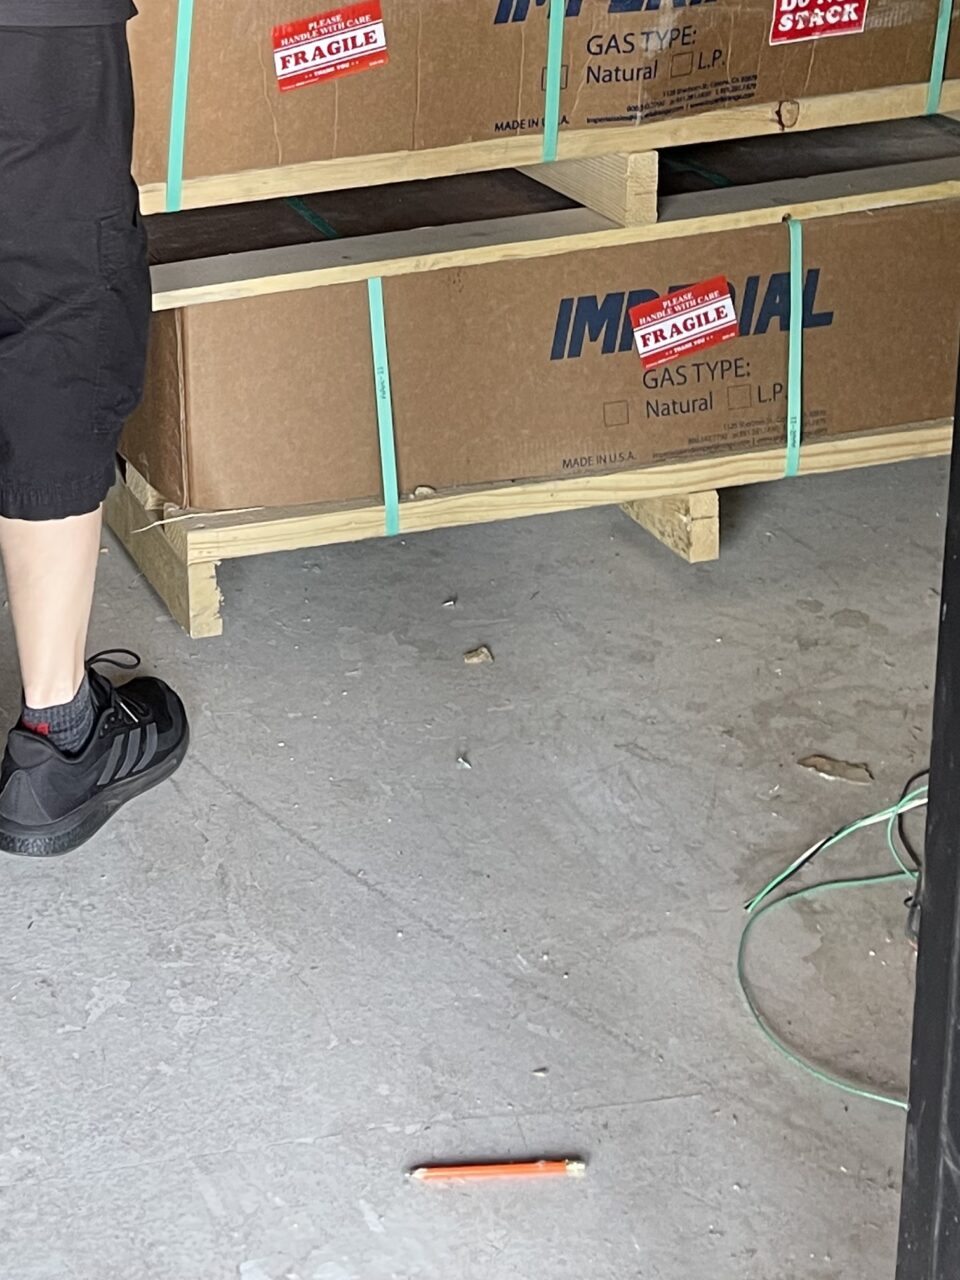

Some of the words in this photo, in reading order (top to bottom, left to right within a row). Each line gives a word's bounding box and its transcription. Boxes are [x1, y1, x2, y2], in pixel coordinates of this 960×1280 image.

[280, 29, 319, 46] HANDLE
[320, 22, 345, 35] WITH
[346, 14, 371, 28] CARE
[308, 14, 342, 30] PLEASE
[778, 3, 859, 31] STACK
[280, 30, 378, 70] FRAGILE
[587, 33, 635, 55] GAS
[640, 25, 697, 52] TYPE:
[586, 60, 658, 84] Natural
[698, 49, 726, 70] L.P.
[495, 118, 525, 132] MADE
[528, 117, 539, 128] IN
[550, 268, 834, 361] IMPIAL
[639, 308, 674, 325] HANDLE
[674, 300, 696, 312] WITH
[697, 290, 720, 304] CARE
[662, 293, 693, 308] PLEASE
[640, 305, 728, 348] FRAGILE
[643, 365, 688, 389] GAS
[693, 358, 751, 383] TYPE:
[646, 392, 713, 419] Natural
[562, 456, 594, 469] MADE
[596, 454, 607, 465] IN
[609, 451, 637, 464] U.S.A.
